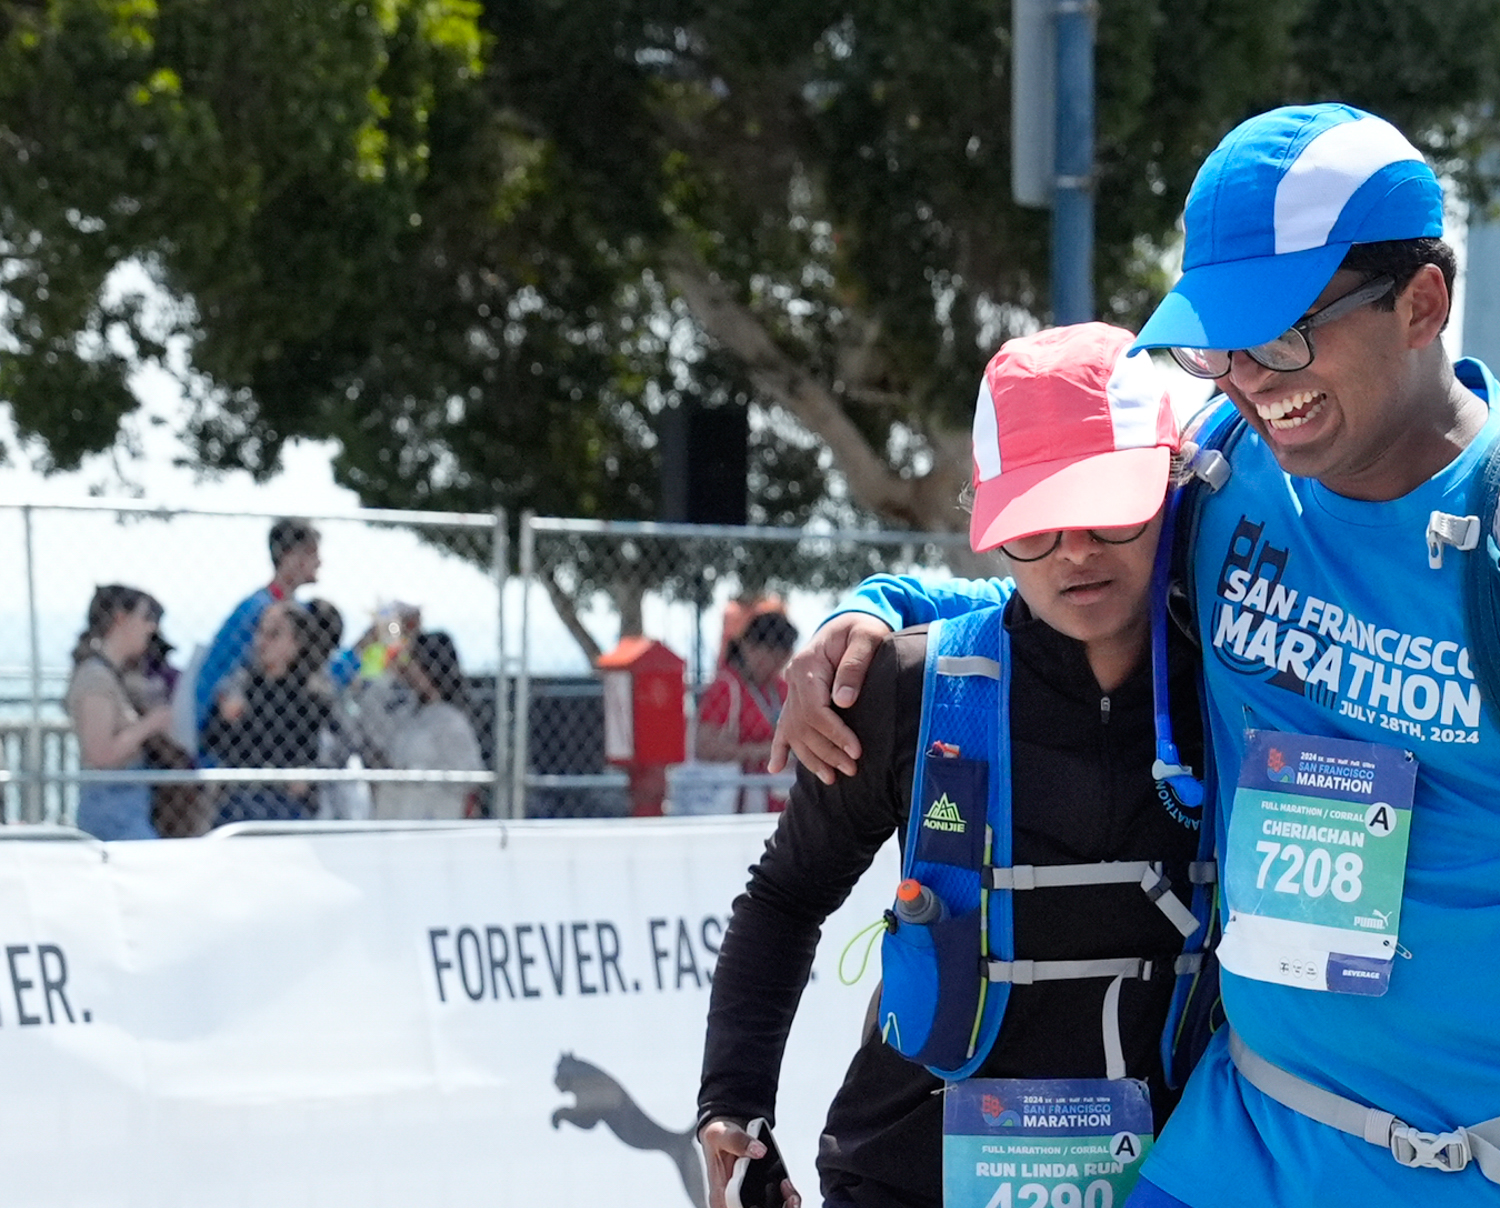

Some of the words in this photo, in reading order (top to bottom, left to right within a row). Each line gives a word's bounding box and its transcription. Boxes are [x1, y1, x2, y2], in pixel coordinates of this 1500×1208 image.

[1223, 569, 1298, 621] SAN
[1213, 603, 1481, 727] MARATHON
[1339, 701, 1376, 724] JULY
[1380, 714, 1426, 741] 28TH,
[1430, 729, 1479, 744] 2024
[1300, 751, 1317, 761] 2024
[1298, 761, 1317, 774] SAN
[1319, 763, 1375, 781] FRANCISCO
[1296, 772, 1373, 794] MARATHON
[1155, 780, 1200, 831] ARATHON
[1261, 801, 1278, 811] FULL
[1280, 803, 1322, 816] MARATHON
[1330, 810, 1364, 823] CORRAL
[1369, 806, 1389, 831] A
[923, 819, 965, 833] AONIJIE
[1262, 820, 1365, 848] CHERIACHAN
[1256, 840, 1363, 902] 7208
[428, 918, 640, 1003] FOREVER.
[0, 944, 92, 1026] ER.
[1342, 969, 1380, 980] BEVERAGE
[1023, 1095, 1043, 1104] 2024
[1023, 1104, 1046, 1114] SAN
[1049, 1104, 1111, 1114] FRANCISCO
[1023, 1114, 1111, 1128] MARATHON
[981, 1145, 1006, 1154] FULL
[1007, 1145, 1061, 1155] MARATHON
[1070, 1145, 1109, 1155] CORRAL
[1115, 1135, 1135, 1157] A
[976, 1162, 1016, 1177] RUN
[1021, 1163, 1079, 1178] LINDA
[1084, 1162, 1124, 1177] RUN
